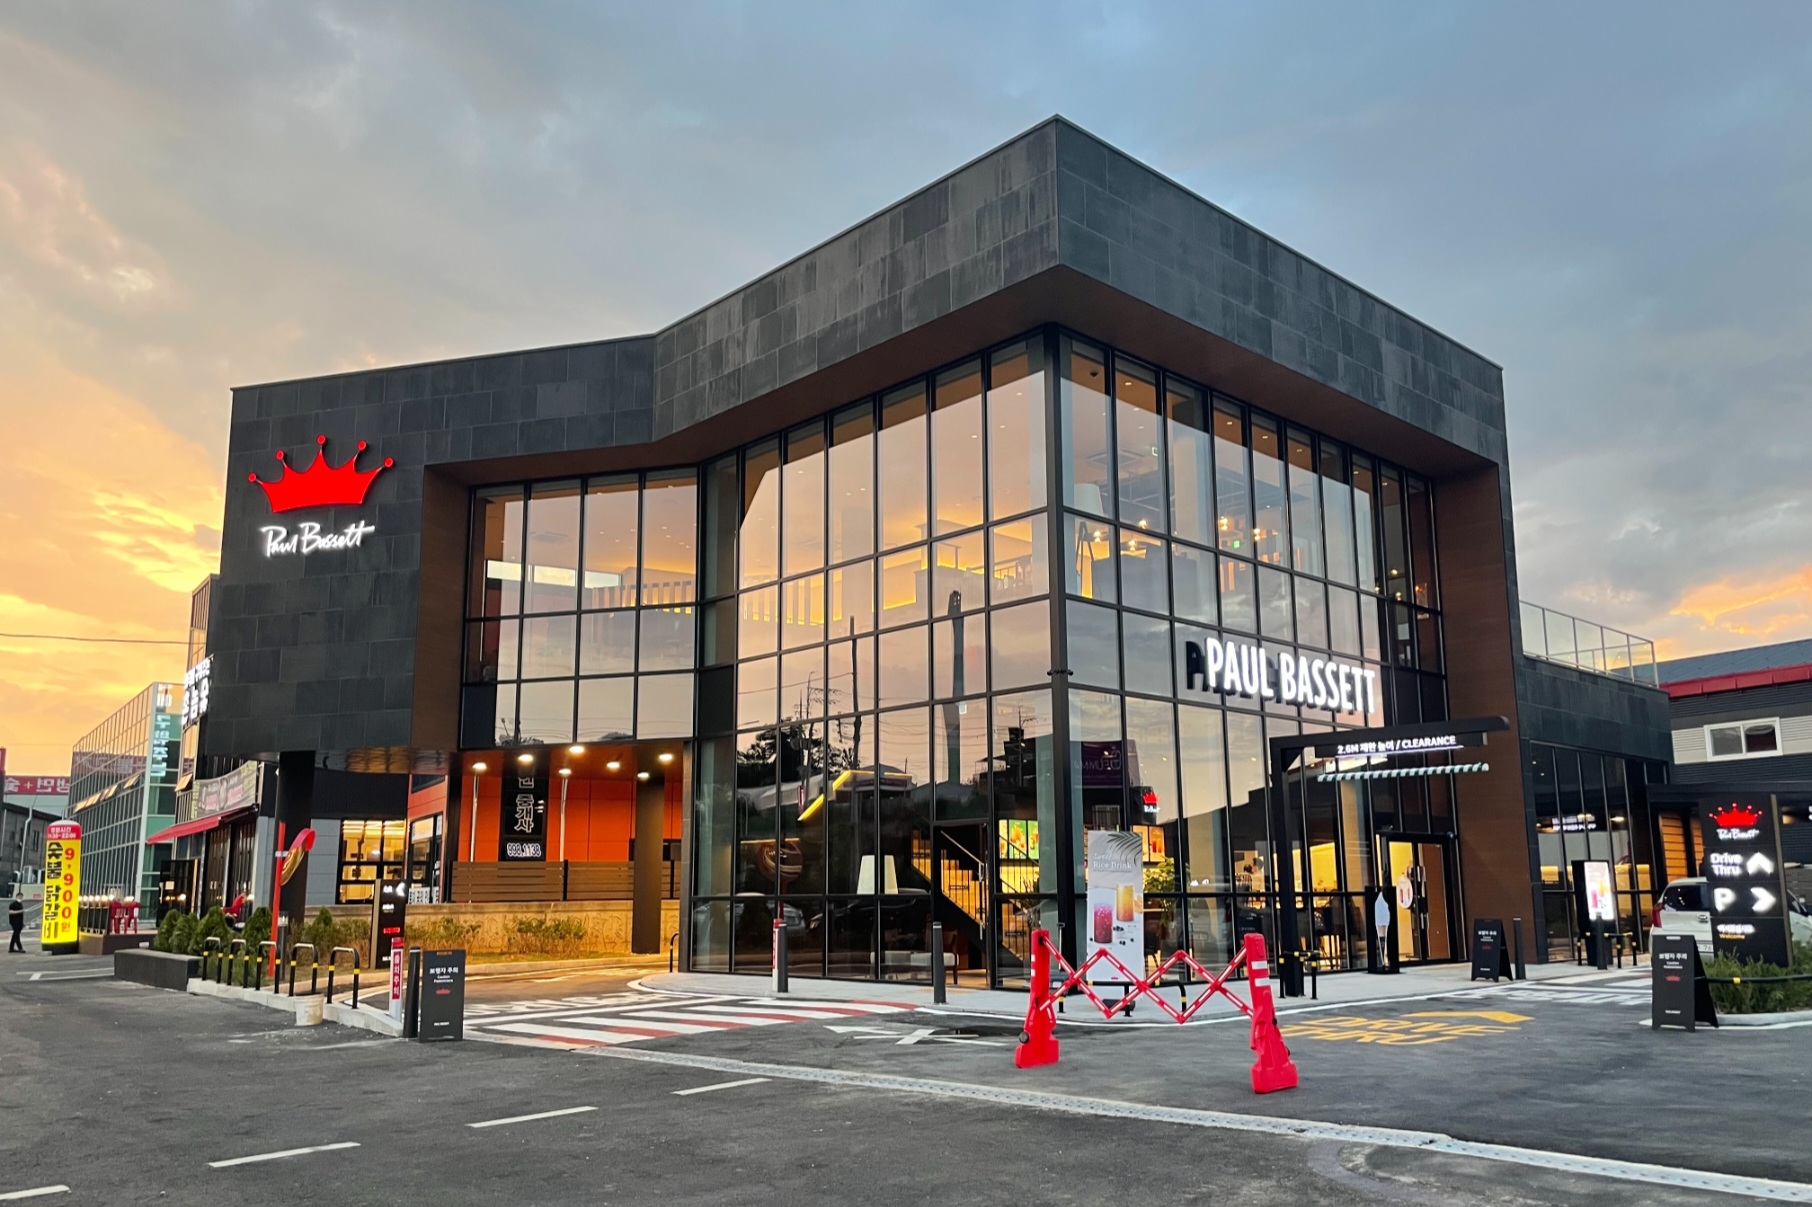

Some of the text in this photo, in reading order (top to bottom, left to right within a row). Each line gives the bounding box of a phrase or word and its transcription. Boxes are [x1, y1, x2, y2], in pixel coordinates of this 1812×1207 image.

[259, 520, 376, 558] Paul Bassett
[1206, 637, 1375, 713] PAUL BASSETT
[1337, 744, 1359, 754] 2.6M
[1402, 735, 1456, 748] CLEARANCE
[1093, 861, 1132, 869] Rice Drink
[1710, 852, 1743, 865] Drive
[1712, 864, 1742, 877] Thru
[1713, 887, 1736, 912] P
[1300, 1016, 1521, 1036] DRIVE
